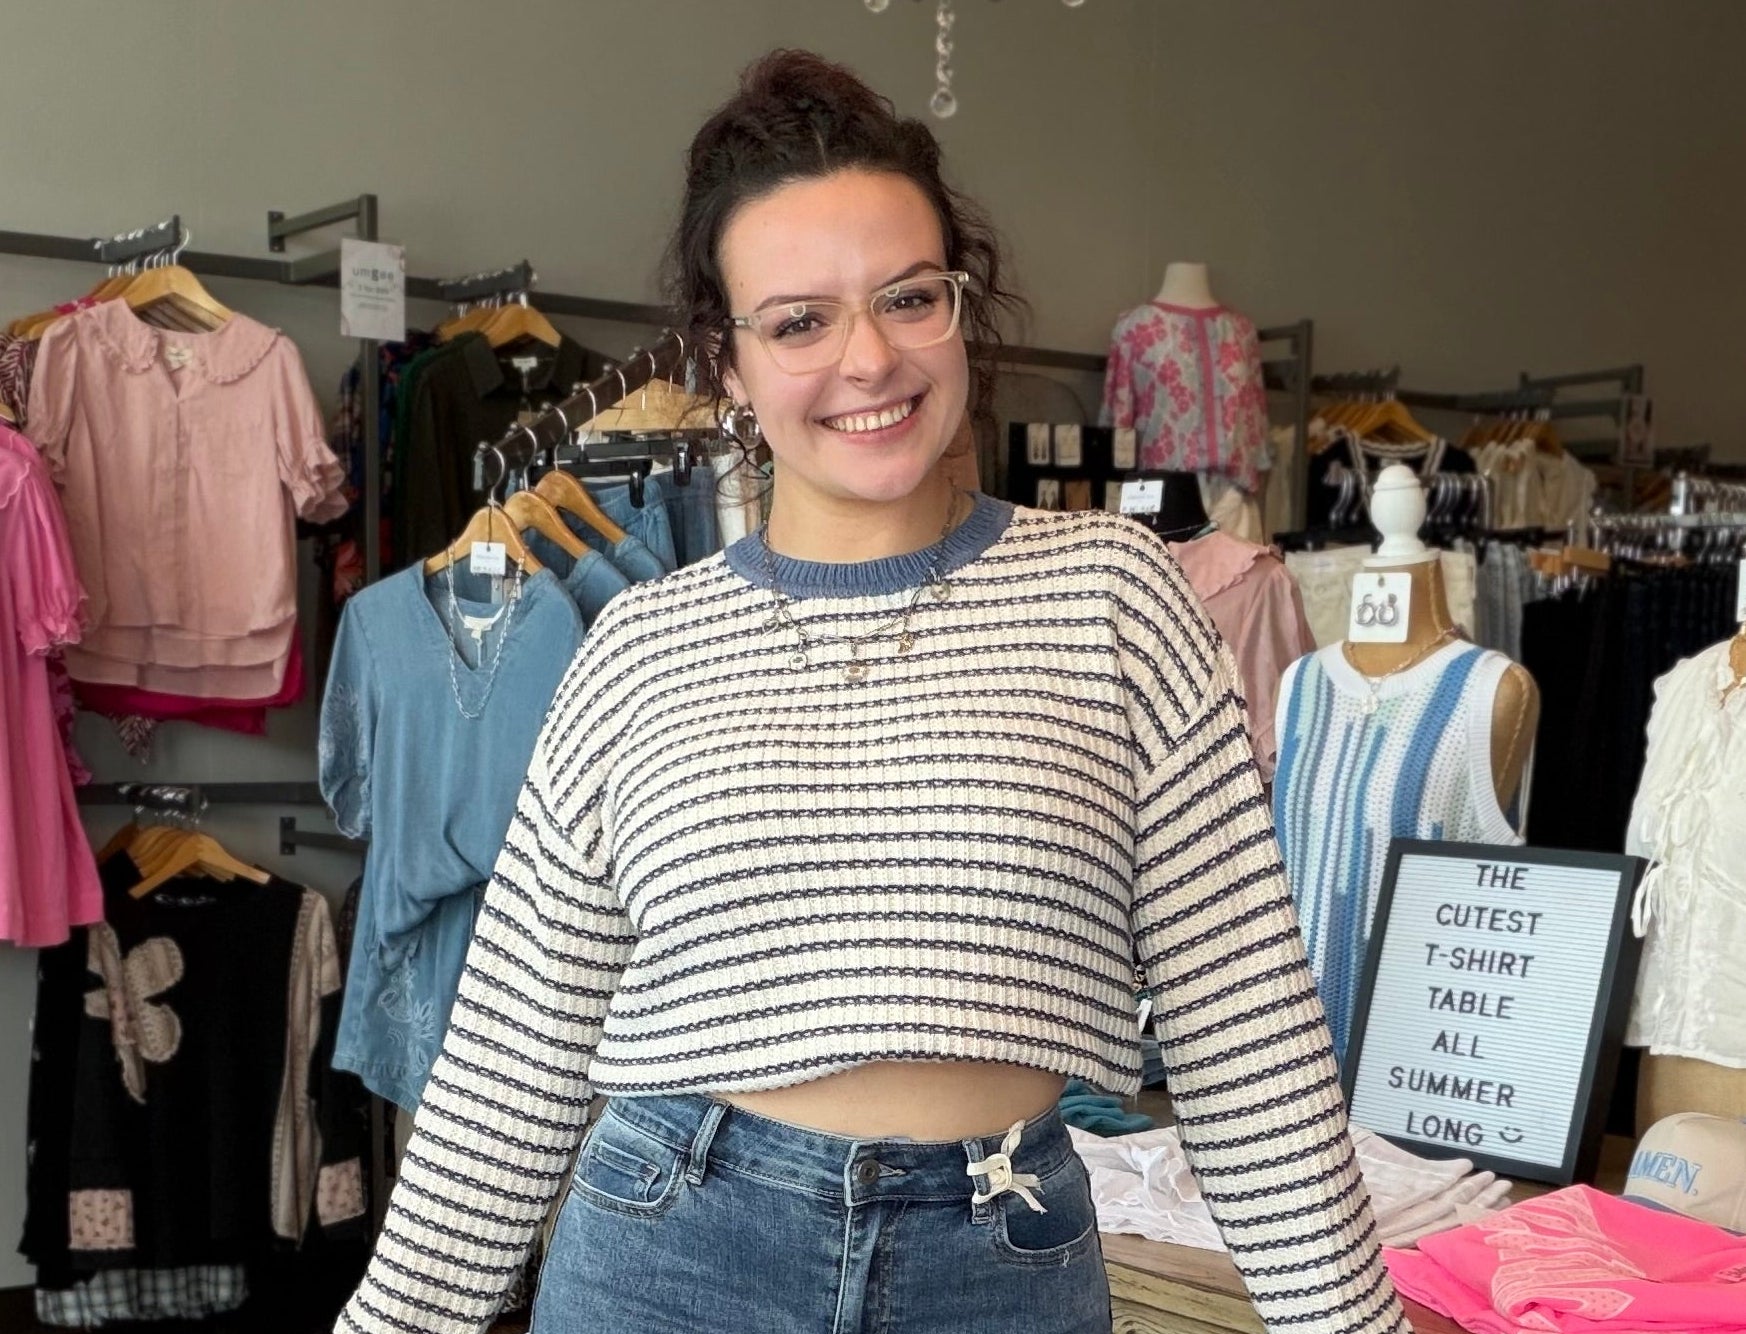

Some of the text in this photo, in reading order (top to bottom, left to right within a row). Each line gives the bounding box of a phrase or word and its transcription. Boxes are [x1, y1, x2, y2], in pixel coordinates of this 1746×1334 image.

[1476, 864, 1529, 890] THE
[1436, 903, 1543, 936] CUTEST
[1425, 943, 1534, 978] T-SHIRT
[1428, 986, 1515, 1020] TABLE
[1431, 1029, 1485, 1059] ALL
[1388, 1066, 1515, 1108] SUMMER
[1405, 1111, 1484, 1146] LONG
[1628, 1150, 1702, 1196] MEN.
